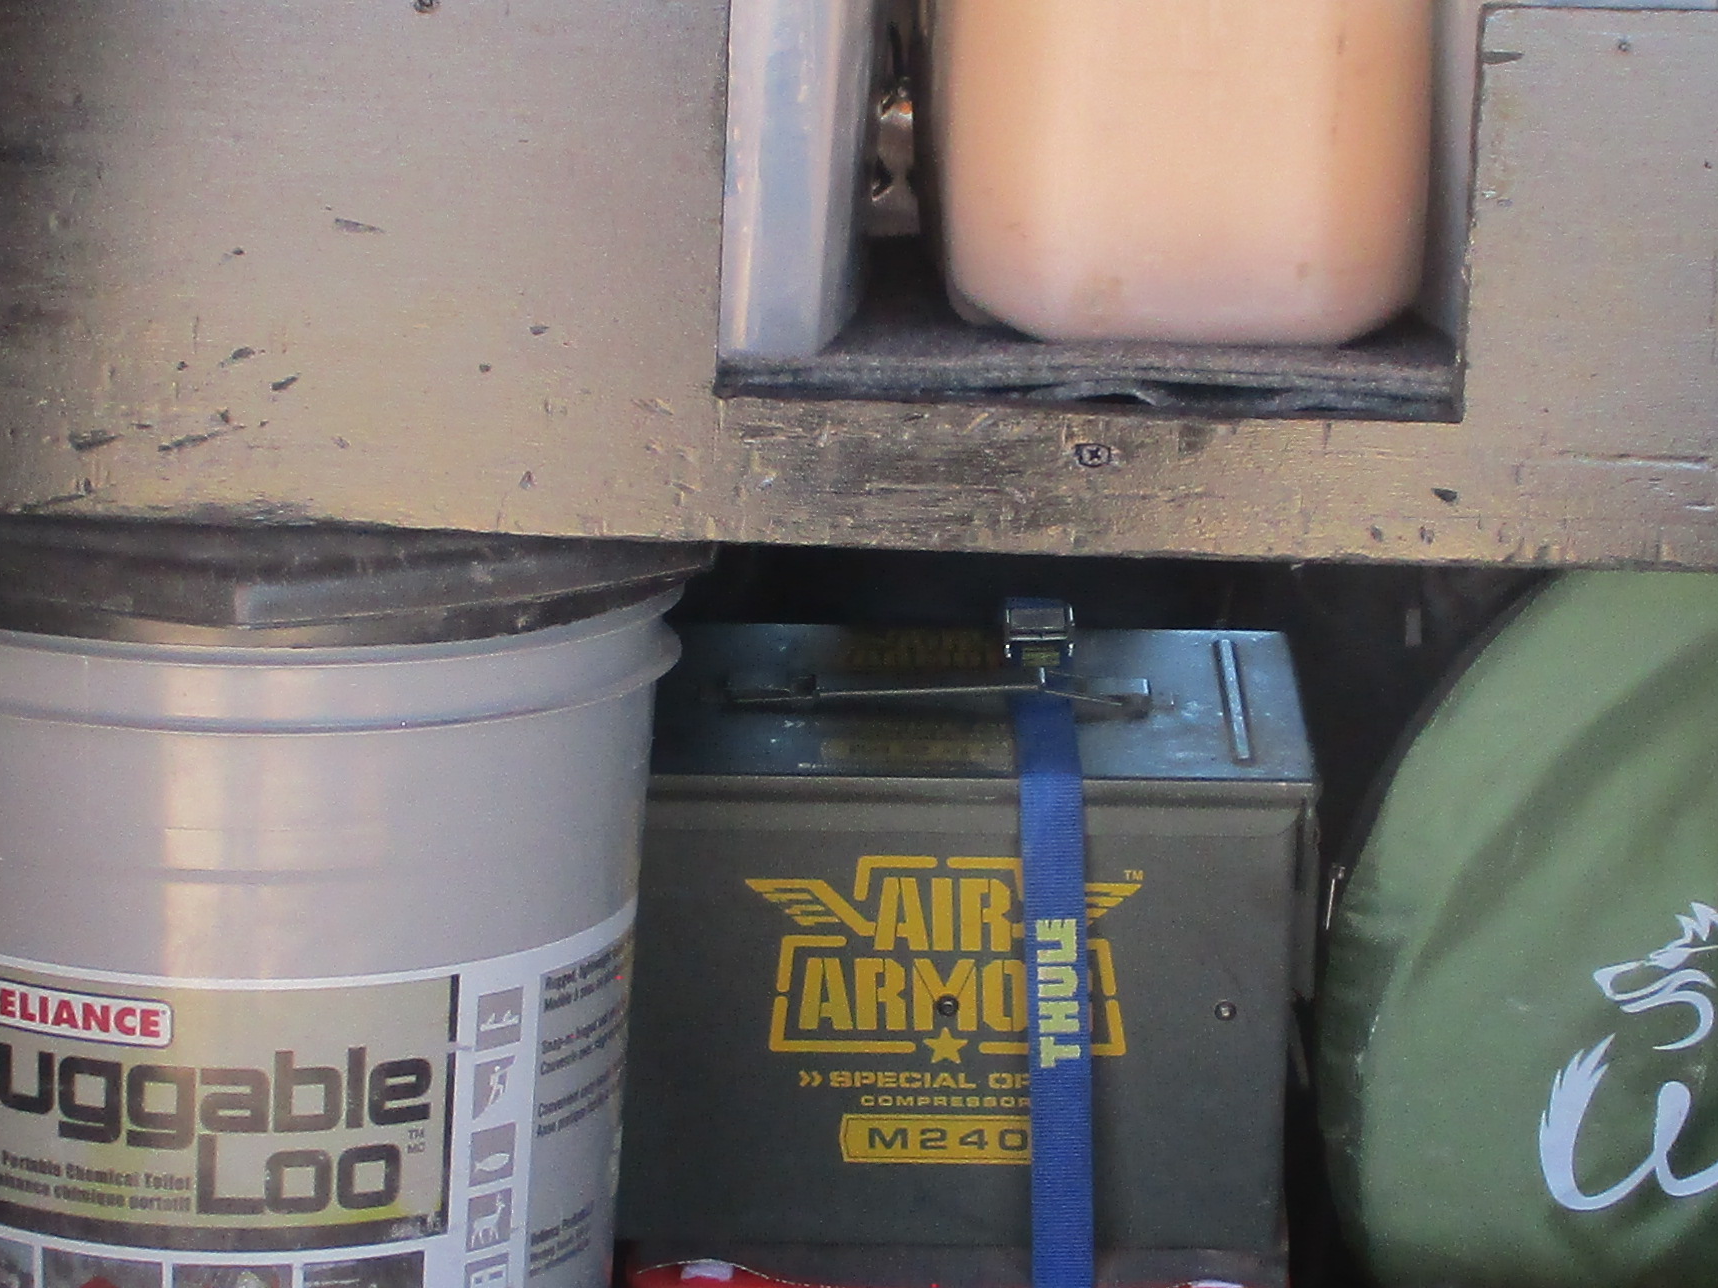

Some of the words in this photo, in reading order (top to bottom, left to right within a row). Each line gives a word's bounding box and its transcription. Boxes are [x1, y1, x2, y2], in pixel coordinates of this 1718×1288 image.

[874, 877, 1011, 952] AIR
[798, 957, 1093, 1032] ARMO
[1035, 918, 1082, 1069] THULE
[829, 1070, 977, 1089] SPECIAL
[988, 1071, 1031, 1090] OP
[860, 1095, 1032, 1108] COMPRESSOR
[196, 1130, 402, 1217] Loo
[867, 1126, 1029, 1152] M240
